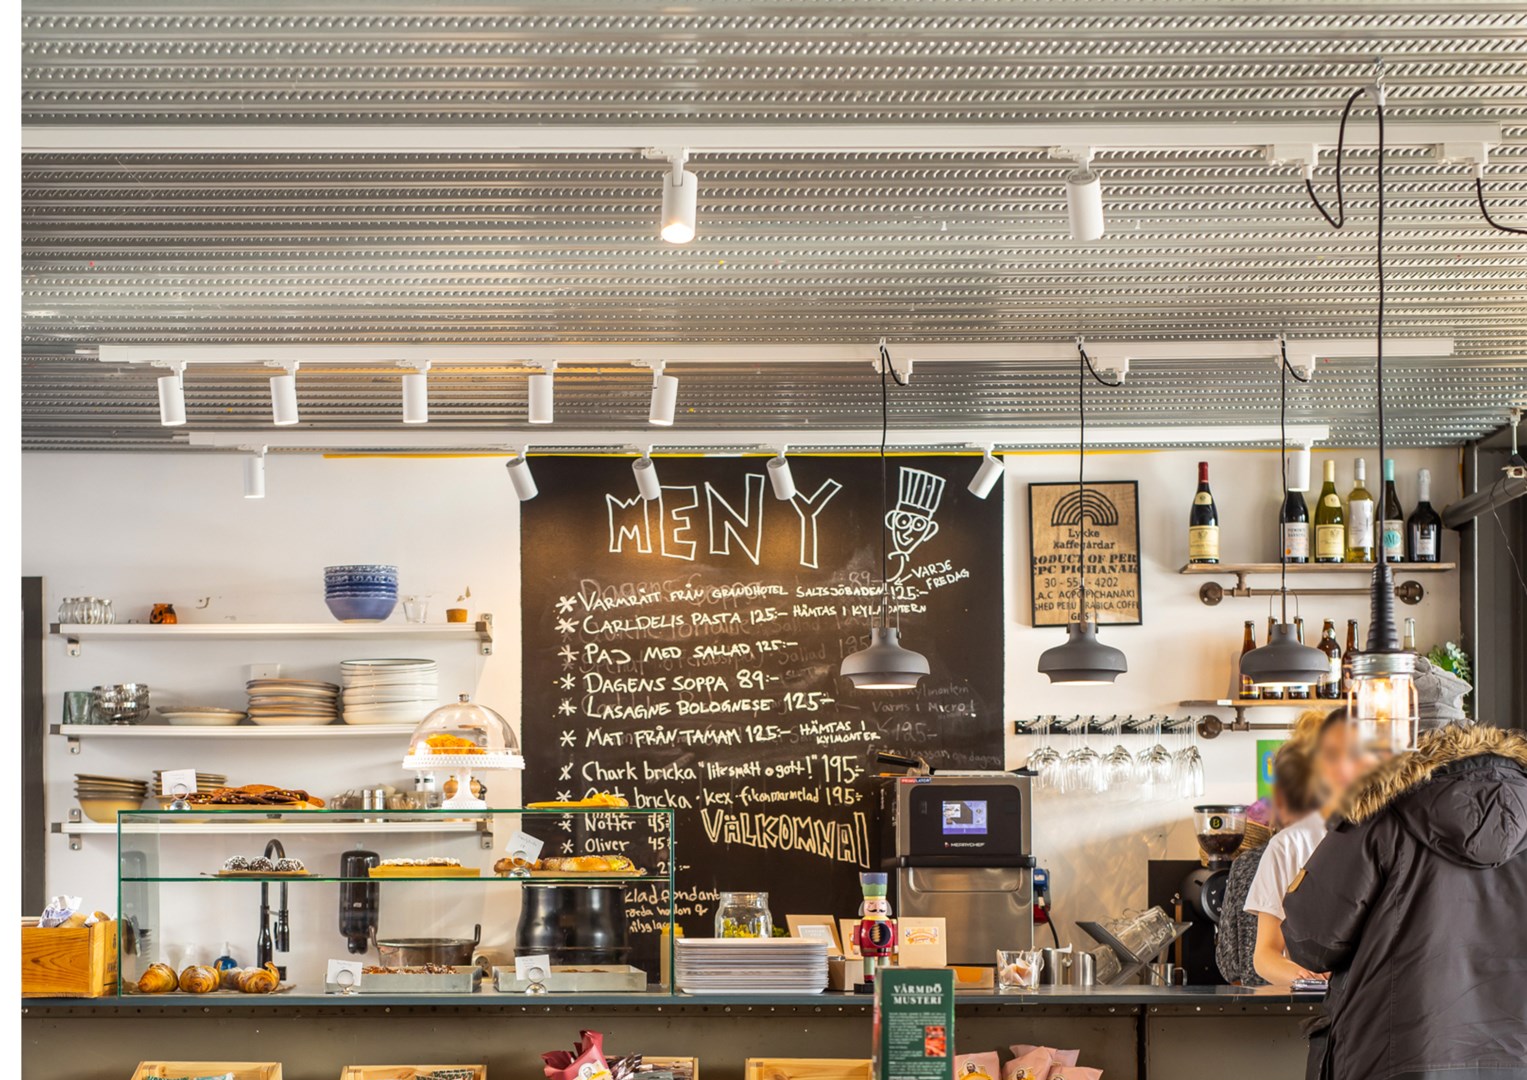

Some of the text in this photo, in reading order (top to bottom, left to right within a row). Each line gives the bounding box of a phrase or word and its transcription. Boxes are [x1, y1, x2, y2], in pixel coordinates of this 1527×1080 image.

[606, 473, 843, 568] MENY
[1088, 554, 1106, 564] OF
[911, 560, 952, 578] VARJE
[926, 568, 970, 590] FREDAG
[1044, 578, 1056, 588] 30
[1095, 577, 1119, 588] 4202
[712, 585, 789, 599] GRANDHOTEL
[1080, 601, 1115, 610] RABICA
[691, 611, 742, 627] PASTA
[584, 642, 632, 665] PAJ
[644, 647, 682, 663] MED
[693, 642, 751, 660] SALLAD
[583, 672, 667, 694] DAGENS
[671, 675, 729, 692] SOPPA
[587, 695, 672, 720] LASAGNE
[676, 698, 774, 717] BOLOGNESE
[585, 730, 623, 748] MAT
[635, 725, 678, 748] FRÅN
[680, 728, 742, 747] TAMAM
[799, 720, 852, 736] HÄMTAS
[633, 786, 693, 809] bricka
[703, 788, 734, 806] kex
[585, 837, 630, 853] Oliver
[893, 996, 942, 1005] MUSTERI
